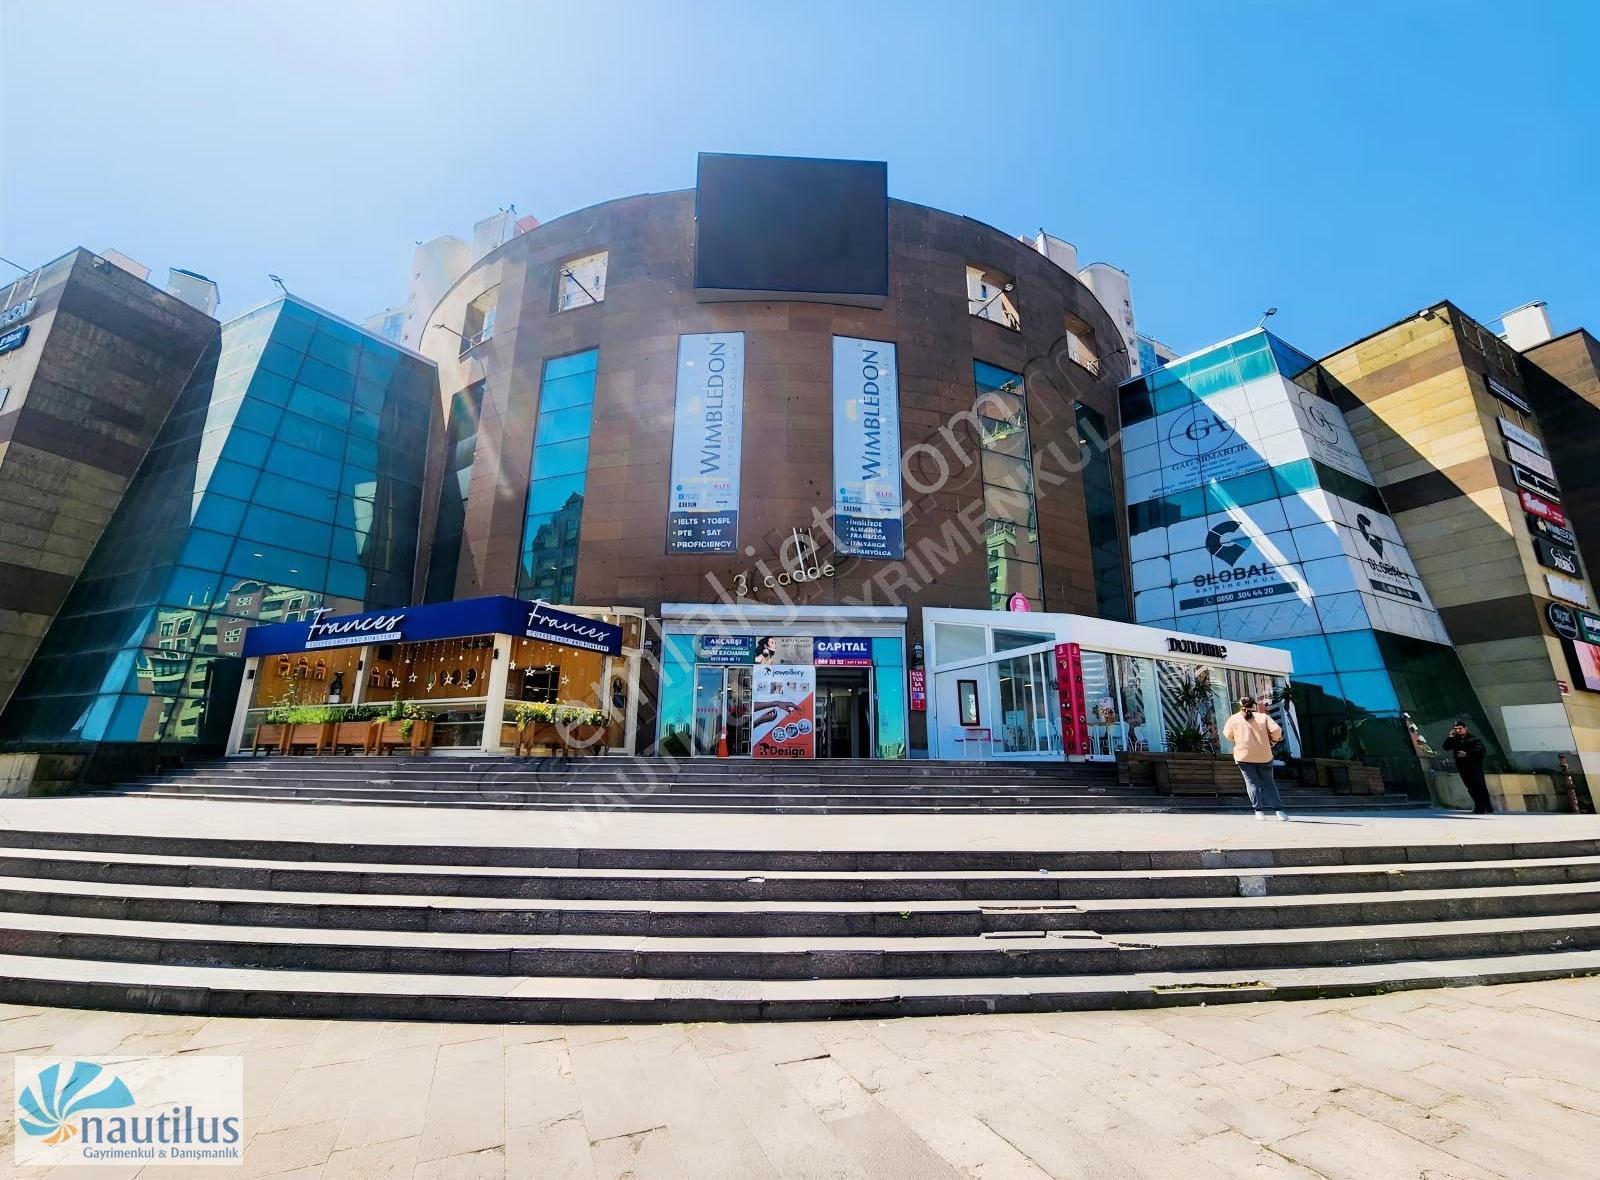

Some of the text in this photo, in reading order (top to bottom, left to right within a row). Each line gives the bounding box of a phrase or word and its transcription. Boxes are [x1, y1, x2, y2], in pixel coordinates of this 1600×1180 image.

[700, 341, 727, 475] WIMBLEDON
[861, 349, 881, 481] WIMBLEDON
[706, 517, 731, 525] TOEFL
[1193, 562, 1276, 588] GLOBAL
[1264, 587, 1274, 595] 20
[307, 607, 405, 641] Frances
[528, 599, 610, 642] Frances
[817, 642, 868, 652] CAPITAL
[772, 668, 805, 677] jewellery
[770, 746, 806, 758] Design
